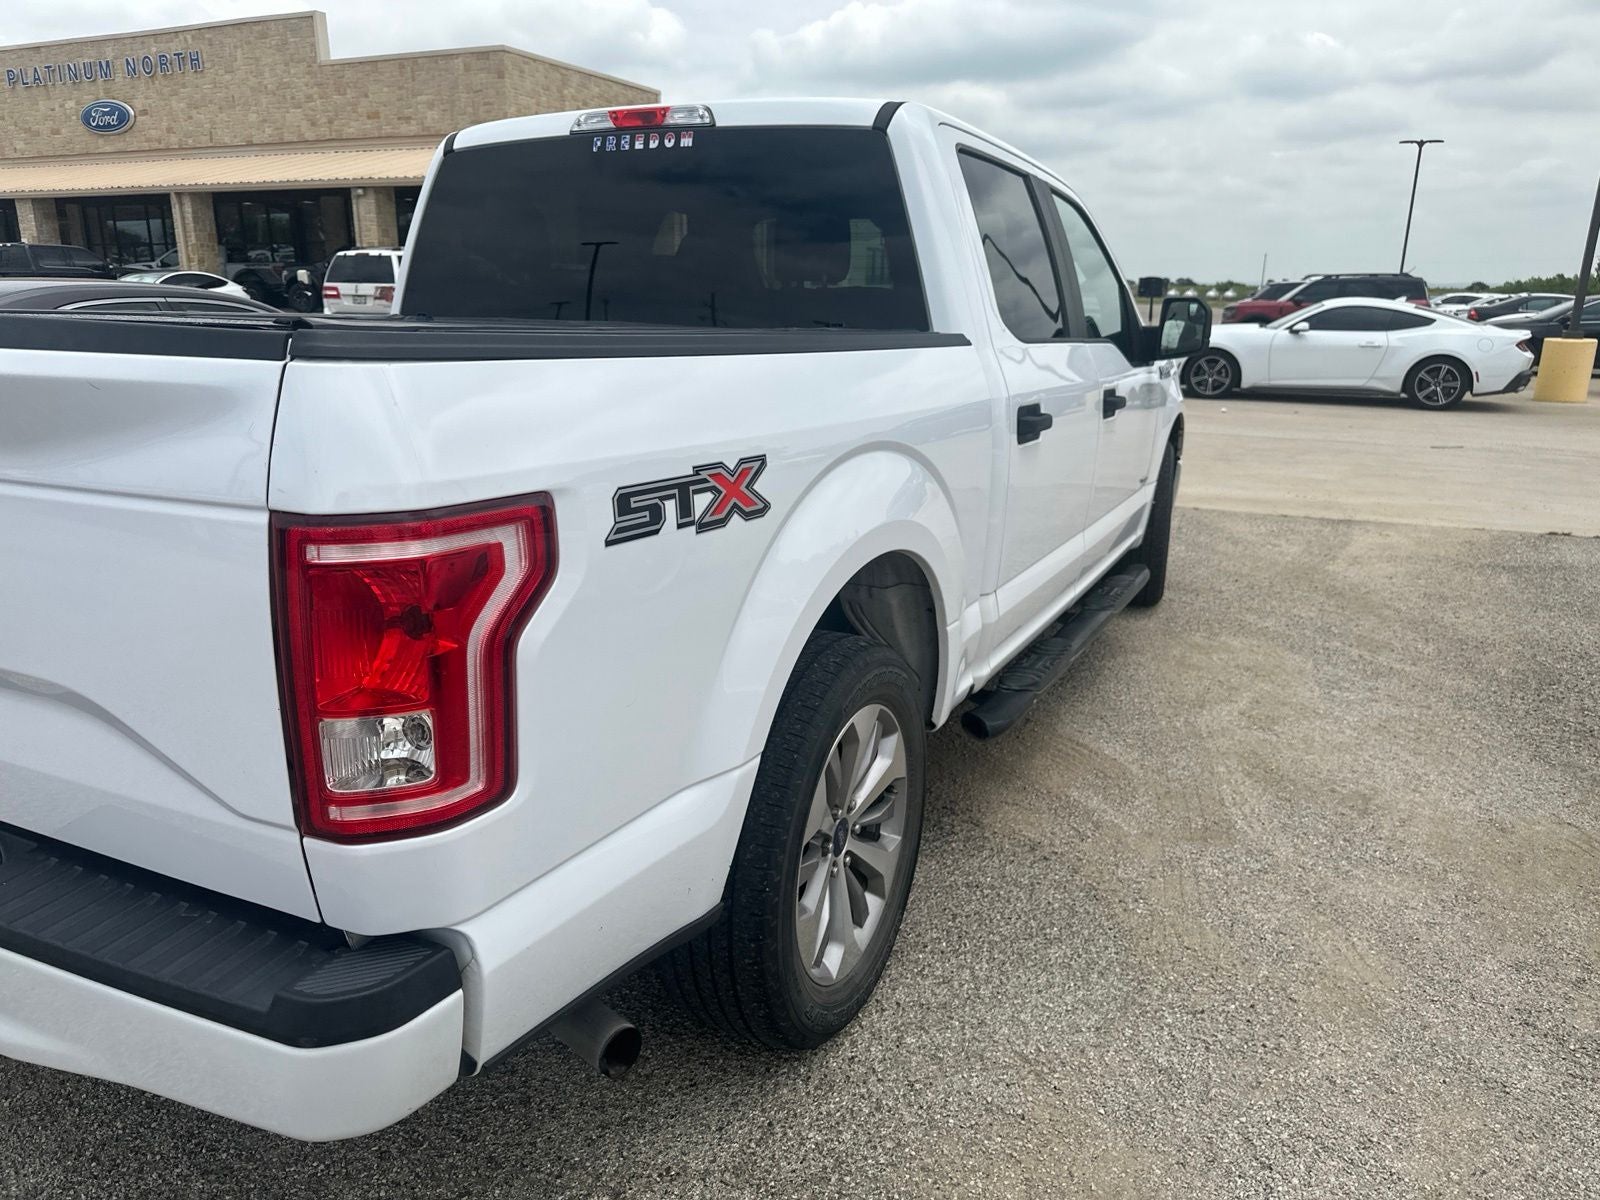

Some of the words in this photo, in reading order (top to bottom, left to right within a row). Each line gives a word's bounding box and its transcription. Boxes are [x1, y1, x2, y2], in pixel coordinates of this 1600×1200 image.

[6, 59, 114, 88] PLATINUM
[125, 50, 203, 77] NORTH
[89, 106, 120, 127] Ford
[592, 131, 694, 153] FREEDOM
[604, 453, 772, 548] STX
